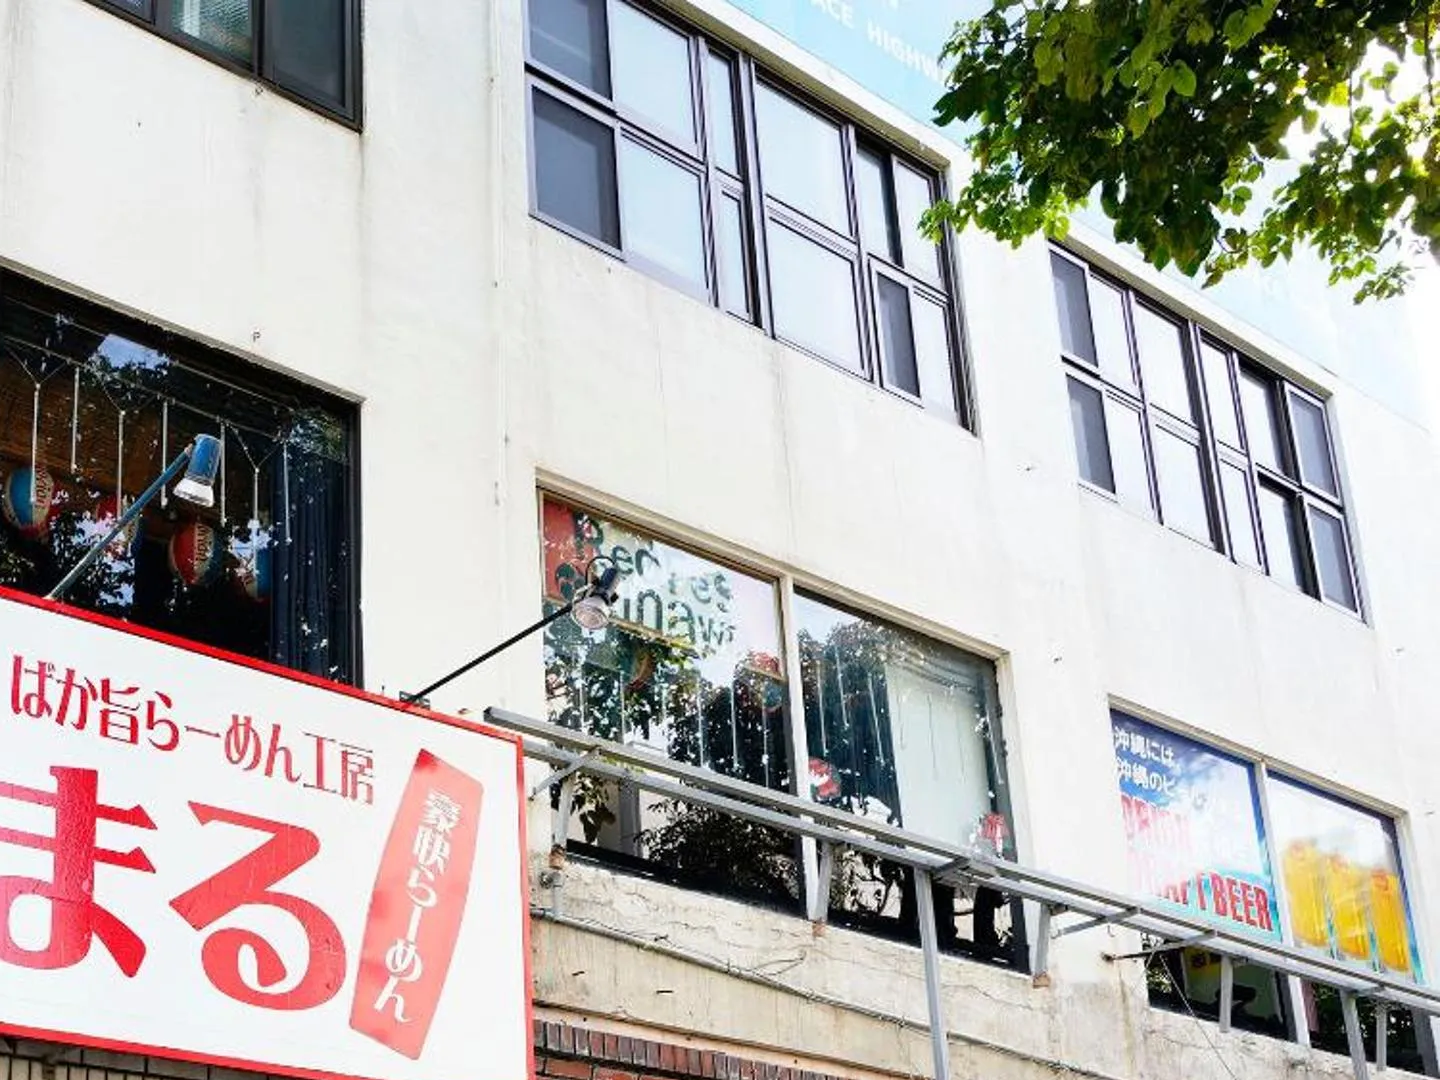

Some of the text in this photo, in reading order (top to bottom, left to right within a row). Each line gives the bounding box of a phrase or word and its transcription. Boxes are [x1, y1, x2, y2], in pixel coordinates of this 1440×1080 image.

[10, 653, 375, 807] ばか旨らーめん工房
[373, 788, 464, 1023] 豪快らーめん
[1209, 870, 1273, 932] BEER
